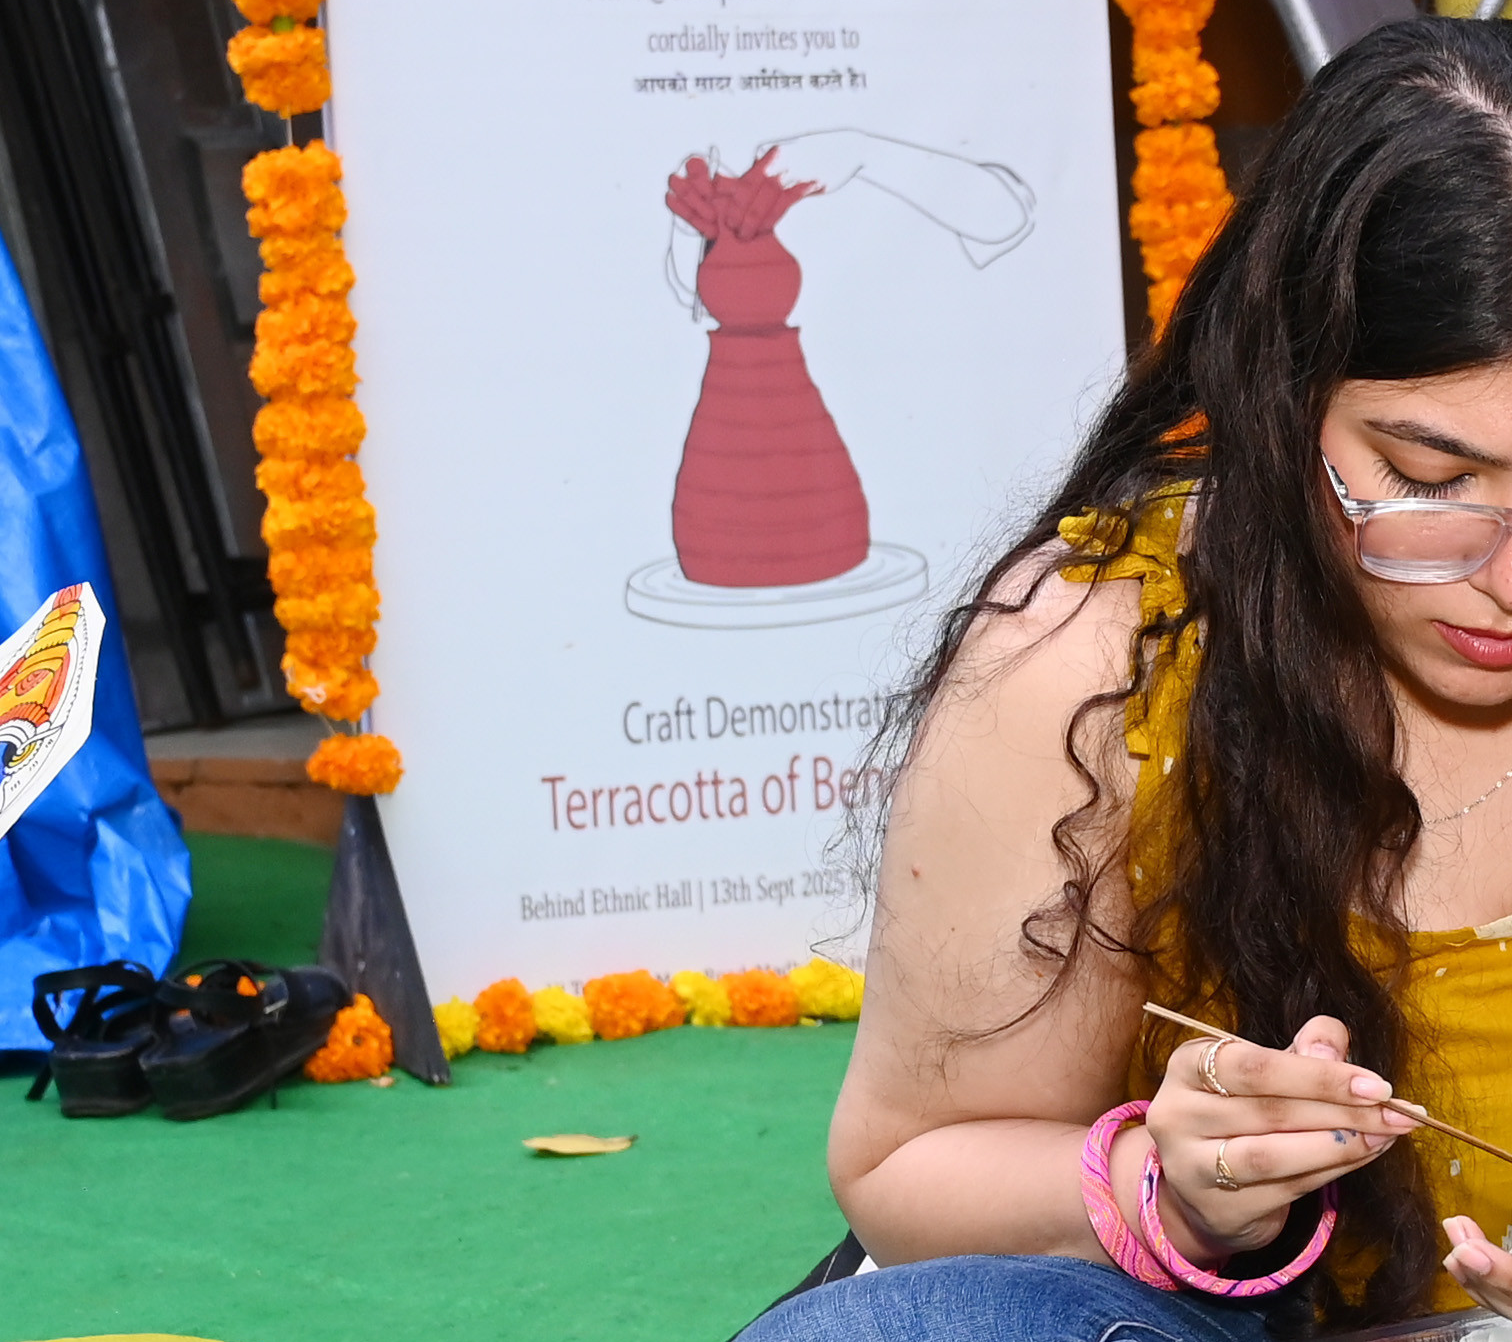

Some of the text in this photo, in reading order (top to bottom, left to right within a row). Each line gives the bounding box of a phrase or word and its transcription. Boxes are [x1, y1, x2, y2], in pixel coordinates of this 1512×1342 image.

[648, 25, 860, 58] cordially invites you to
[623, 690, 889, 745] Craft Demonstrat
[541, 755, 894, 831] Terracotta of Ben
[520, 889, 586, 922] Behind
[592, 886, 651, 915] Ethnic
[656, 880, 693, 909] Hall
[711, 875, 752, 906] 13th
[756, 873, 795, 907] Sept
[801, 867, 846, 898] 2025
